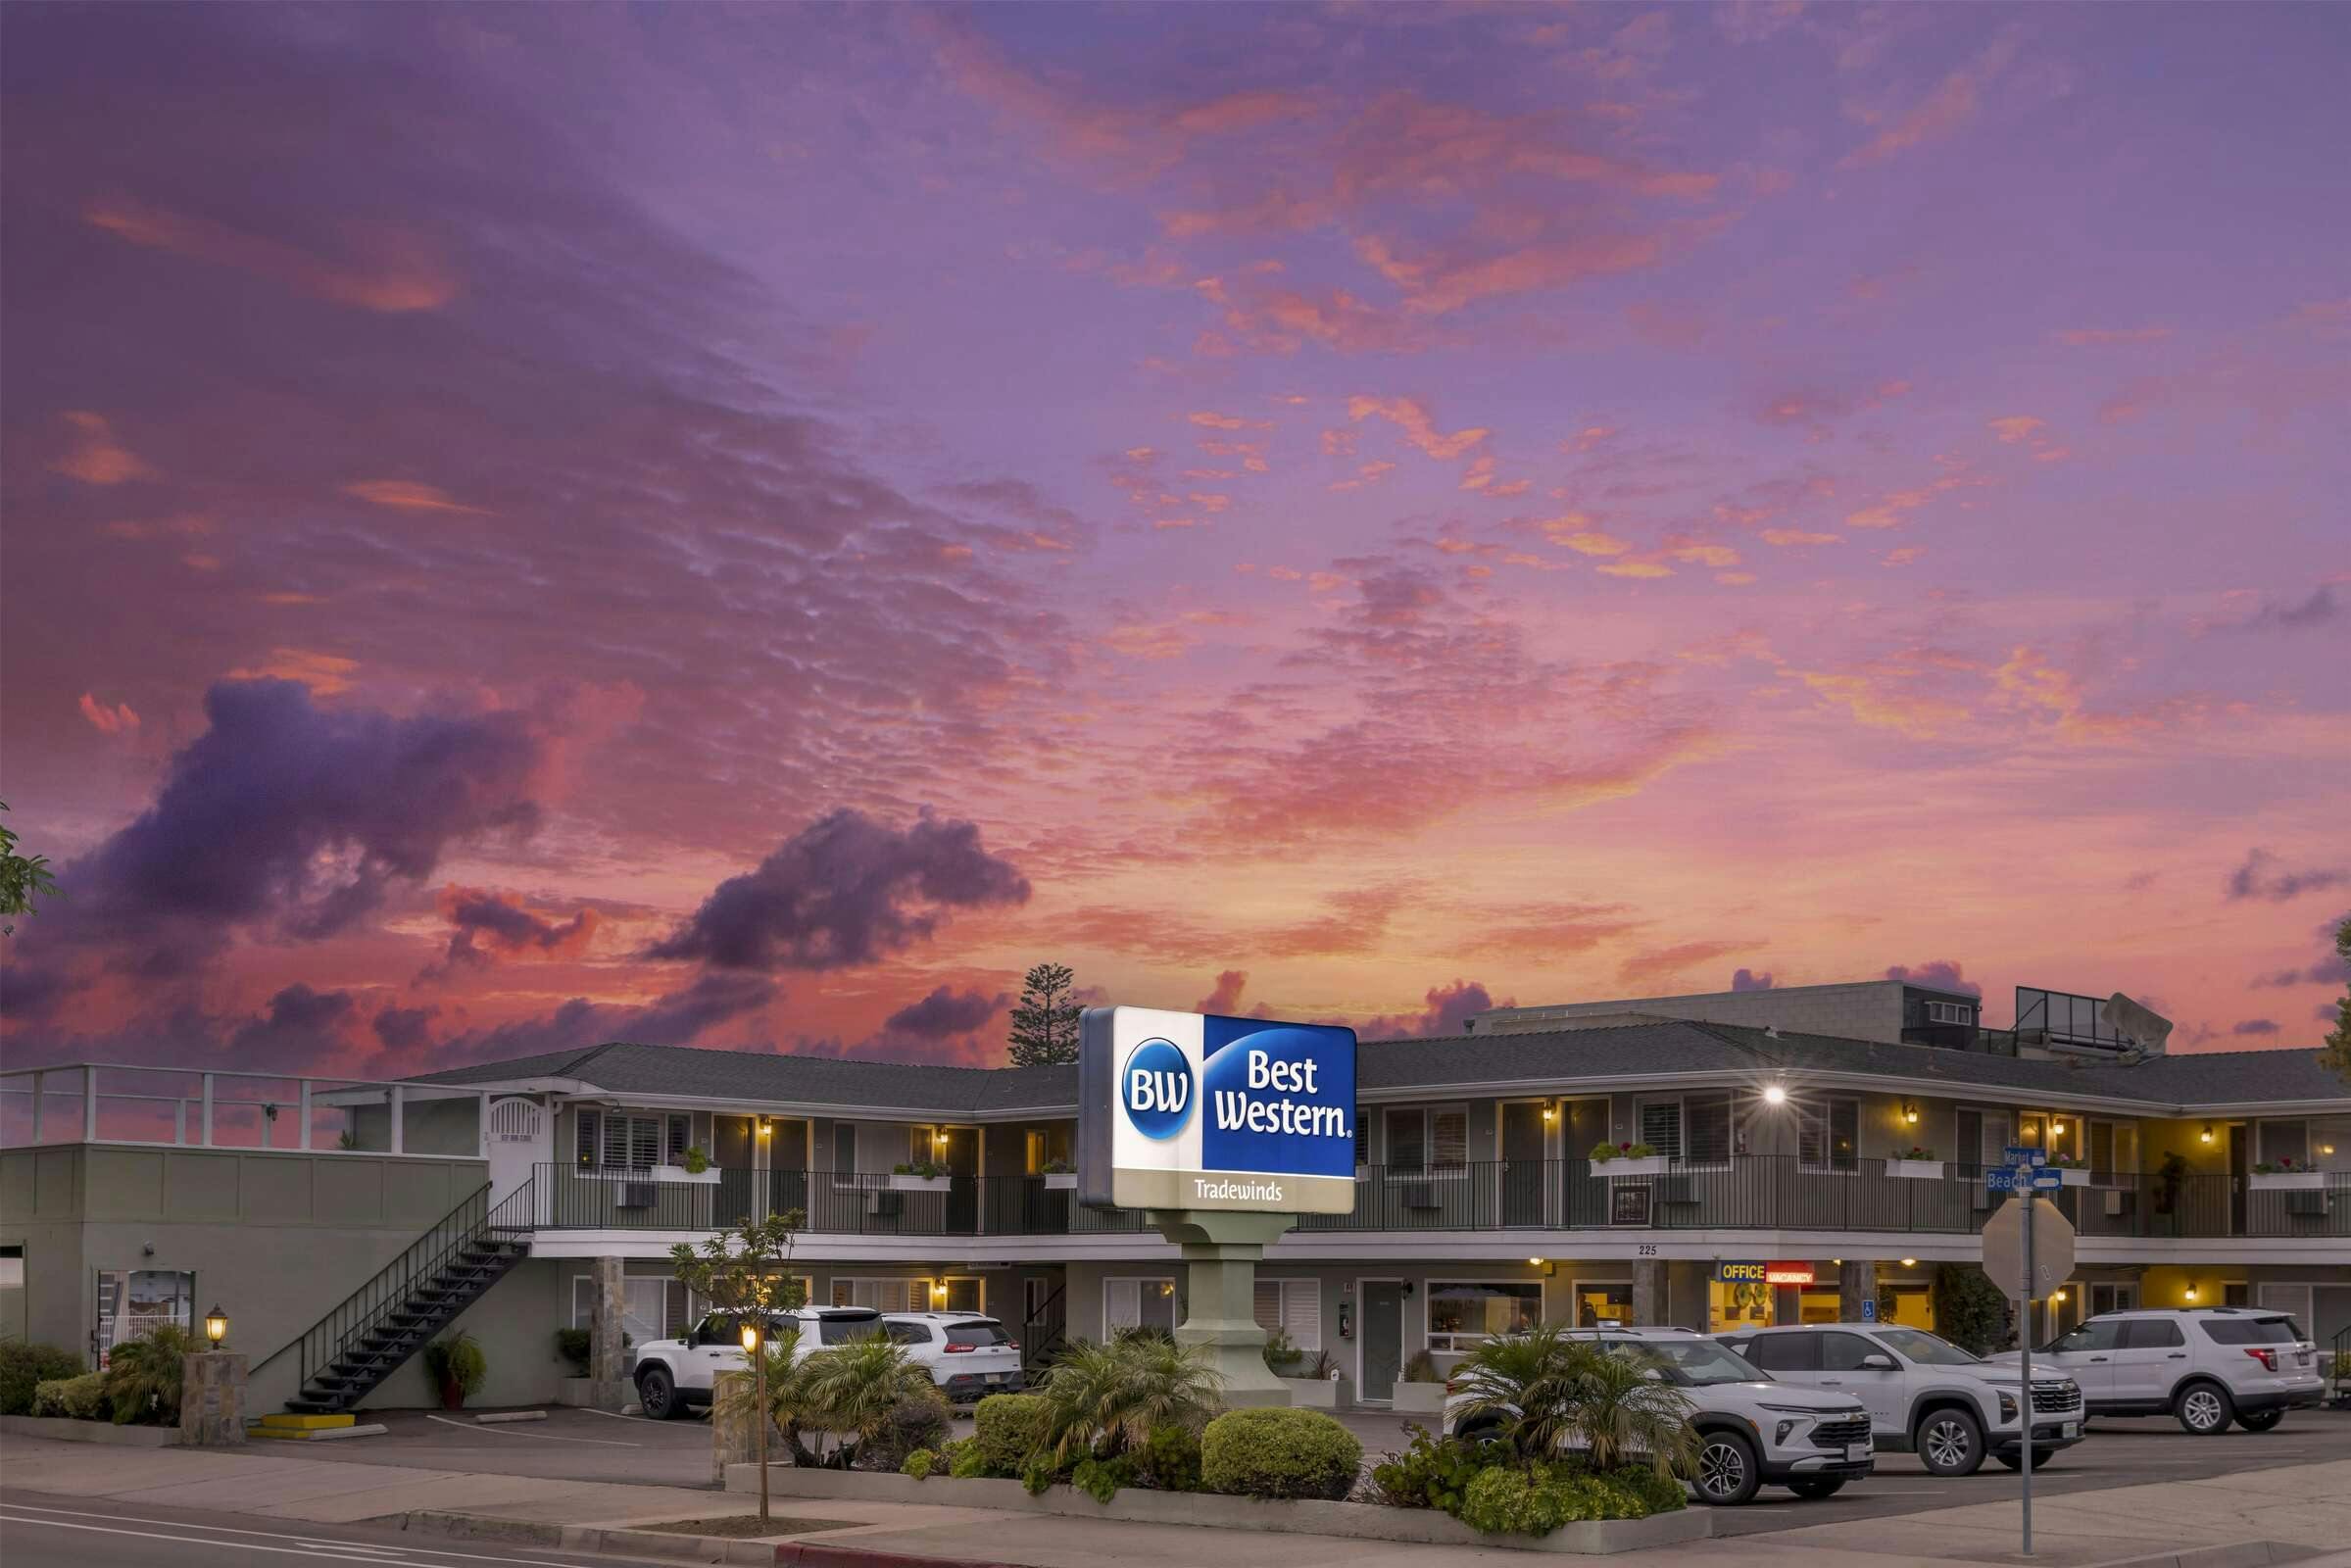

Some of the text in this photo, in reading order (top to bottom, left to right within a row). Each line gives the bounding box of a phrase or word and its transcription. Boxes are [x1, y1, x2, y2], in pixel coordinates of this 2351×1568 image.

[1249, 1050, 1318, 1095] Best
[1131, 1069, 1189, 1113] BW
[1195, 1179, 1283, 1201] Tradewinds
[1987, 1174, 2027, 1188] Beach
[1640, 1246, 1656, 1255] 225
[1723, 1265, 1765, 1279] OFFICE
